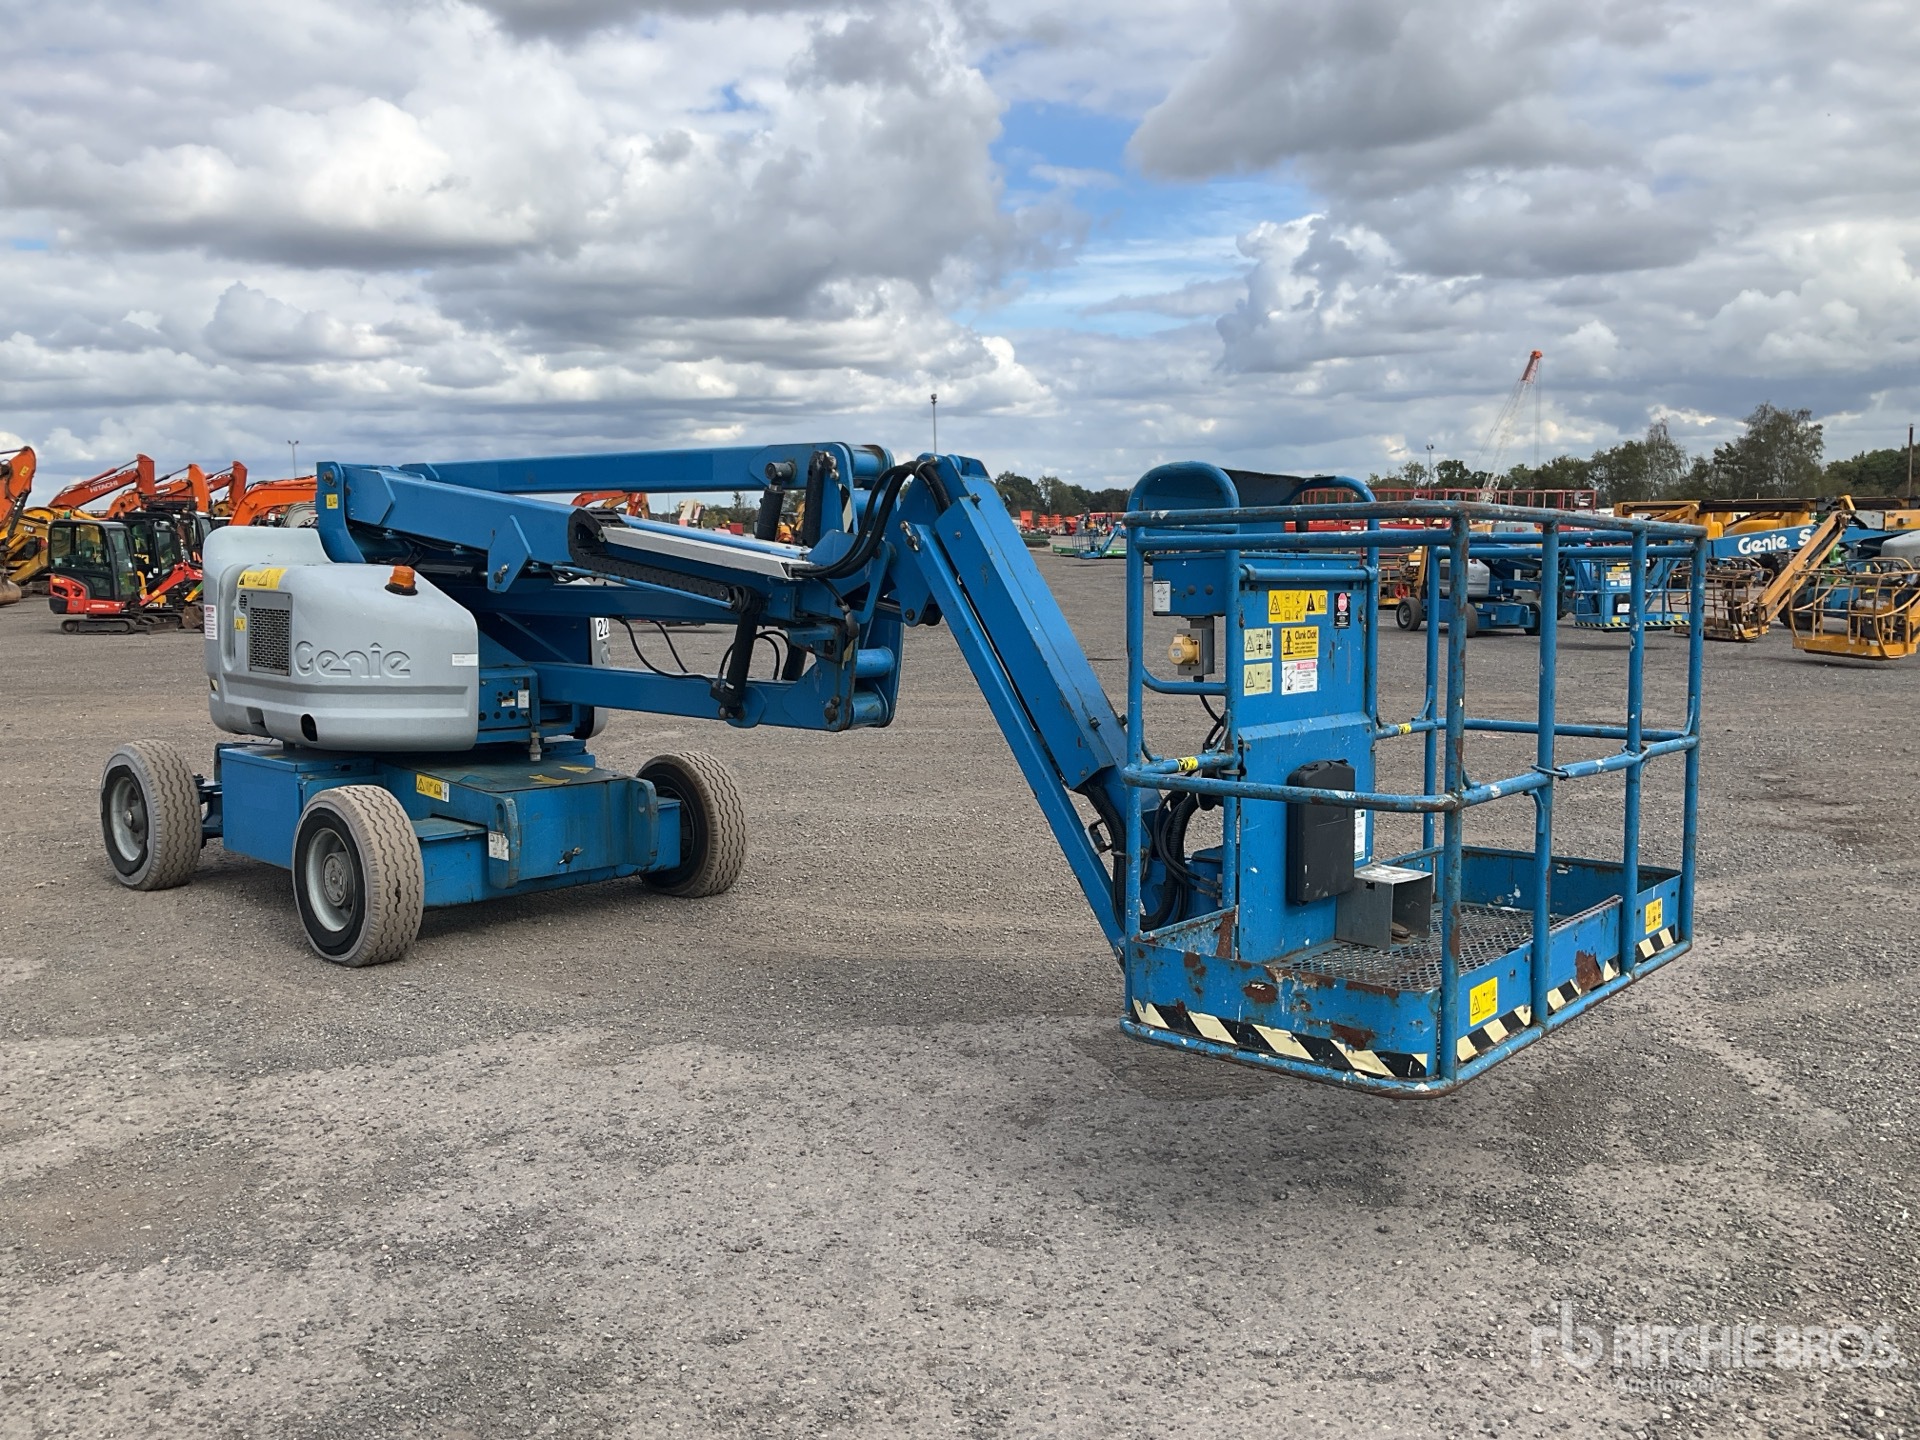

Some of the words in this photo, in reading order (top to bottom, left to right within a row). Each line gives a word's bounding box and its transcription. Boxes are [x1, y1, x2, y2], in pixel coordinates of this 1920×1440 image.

[89, 480, 119, 493] HITACHI
[1738, 533, 1788, 555] Genie
[295, 640, 411, 678] Genie
